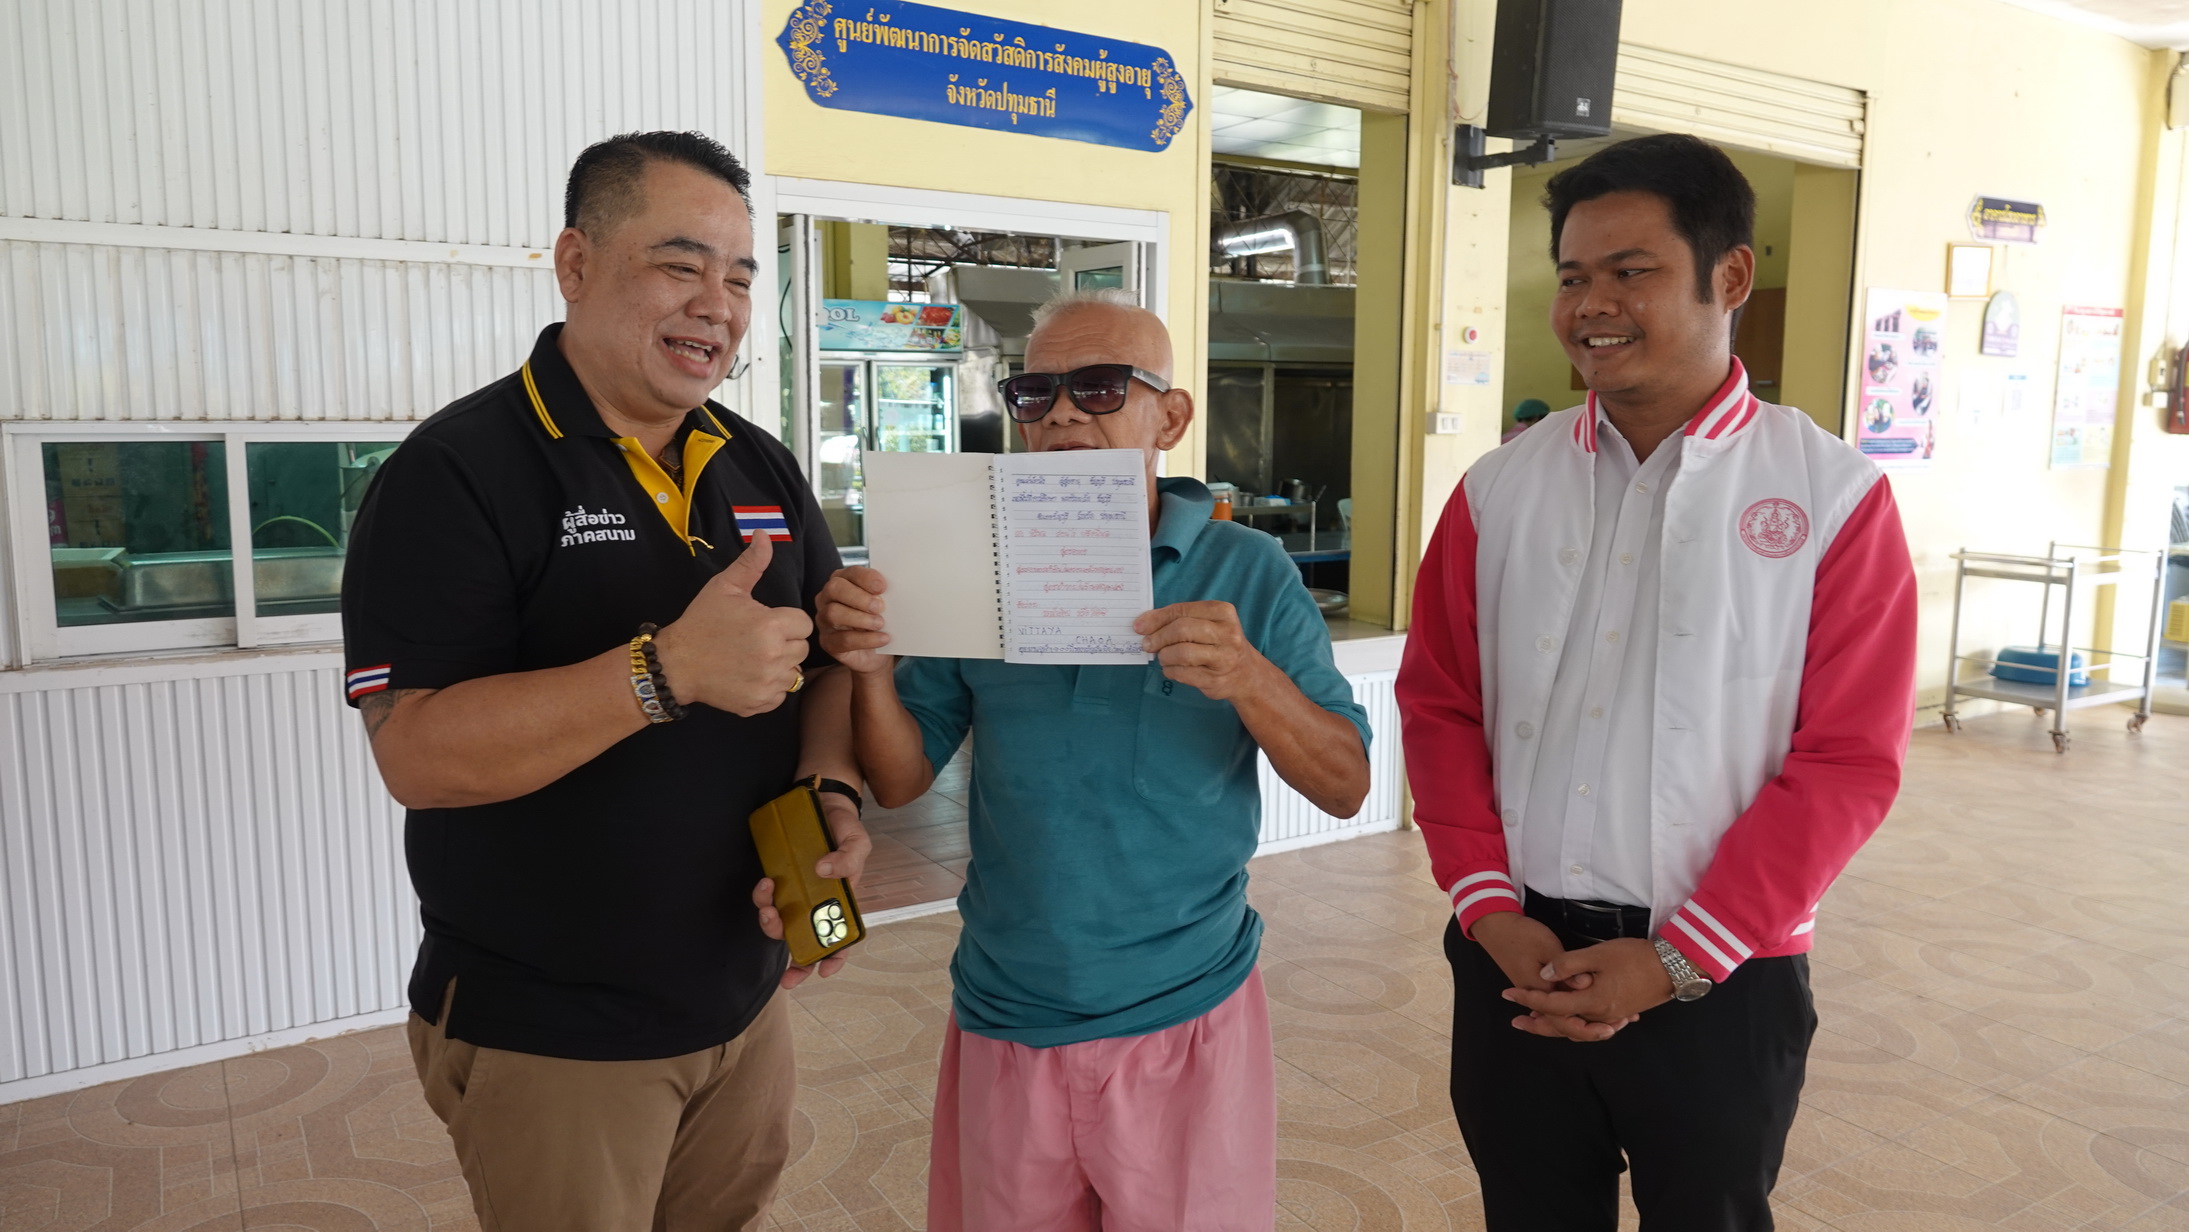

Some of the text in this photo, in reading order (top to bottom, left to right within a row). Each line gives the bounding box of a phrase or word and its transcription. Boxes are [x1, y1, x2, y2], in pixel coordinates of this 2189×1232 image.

[833, 9, 1152, 99] ศูนย์พัฒนาการจัดสวัสดิการสังคมผู้สูงอายุ
[945, 74, 1057, 125] จังหวัดปทุมธานี
[822, 307, 860, 322] OL
[562, 505, 626, 533] ผู้สื่อข่าว
[560, 529, 636, 548] ภาคสนาม
